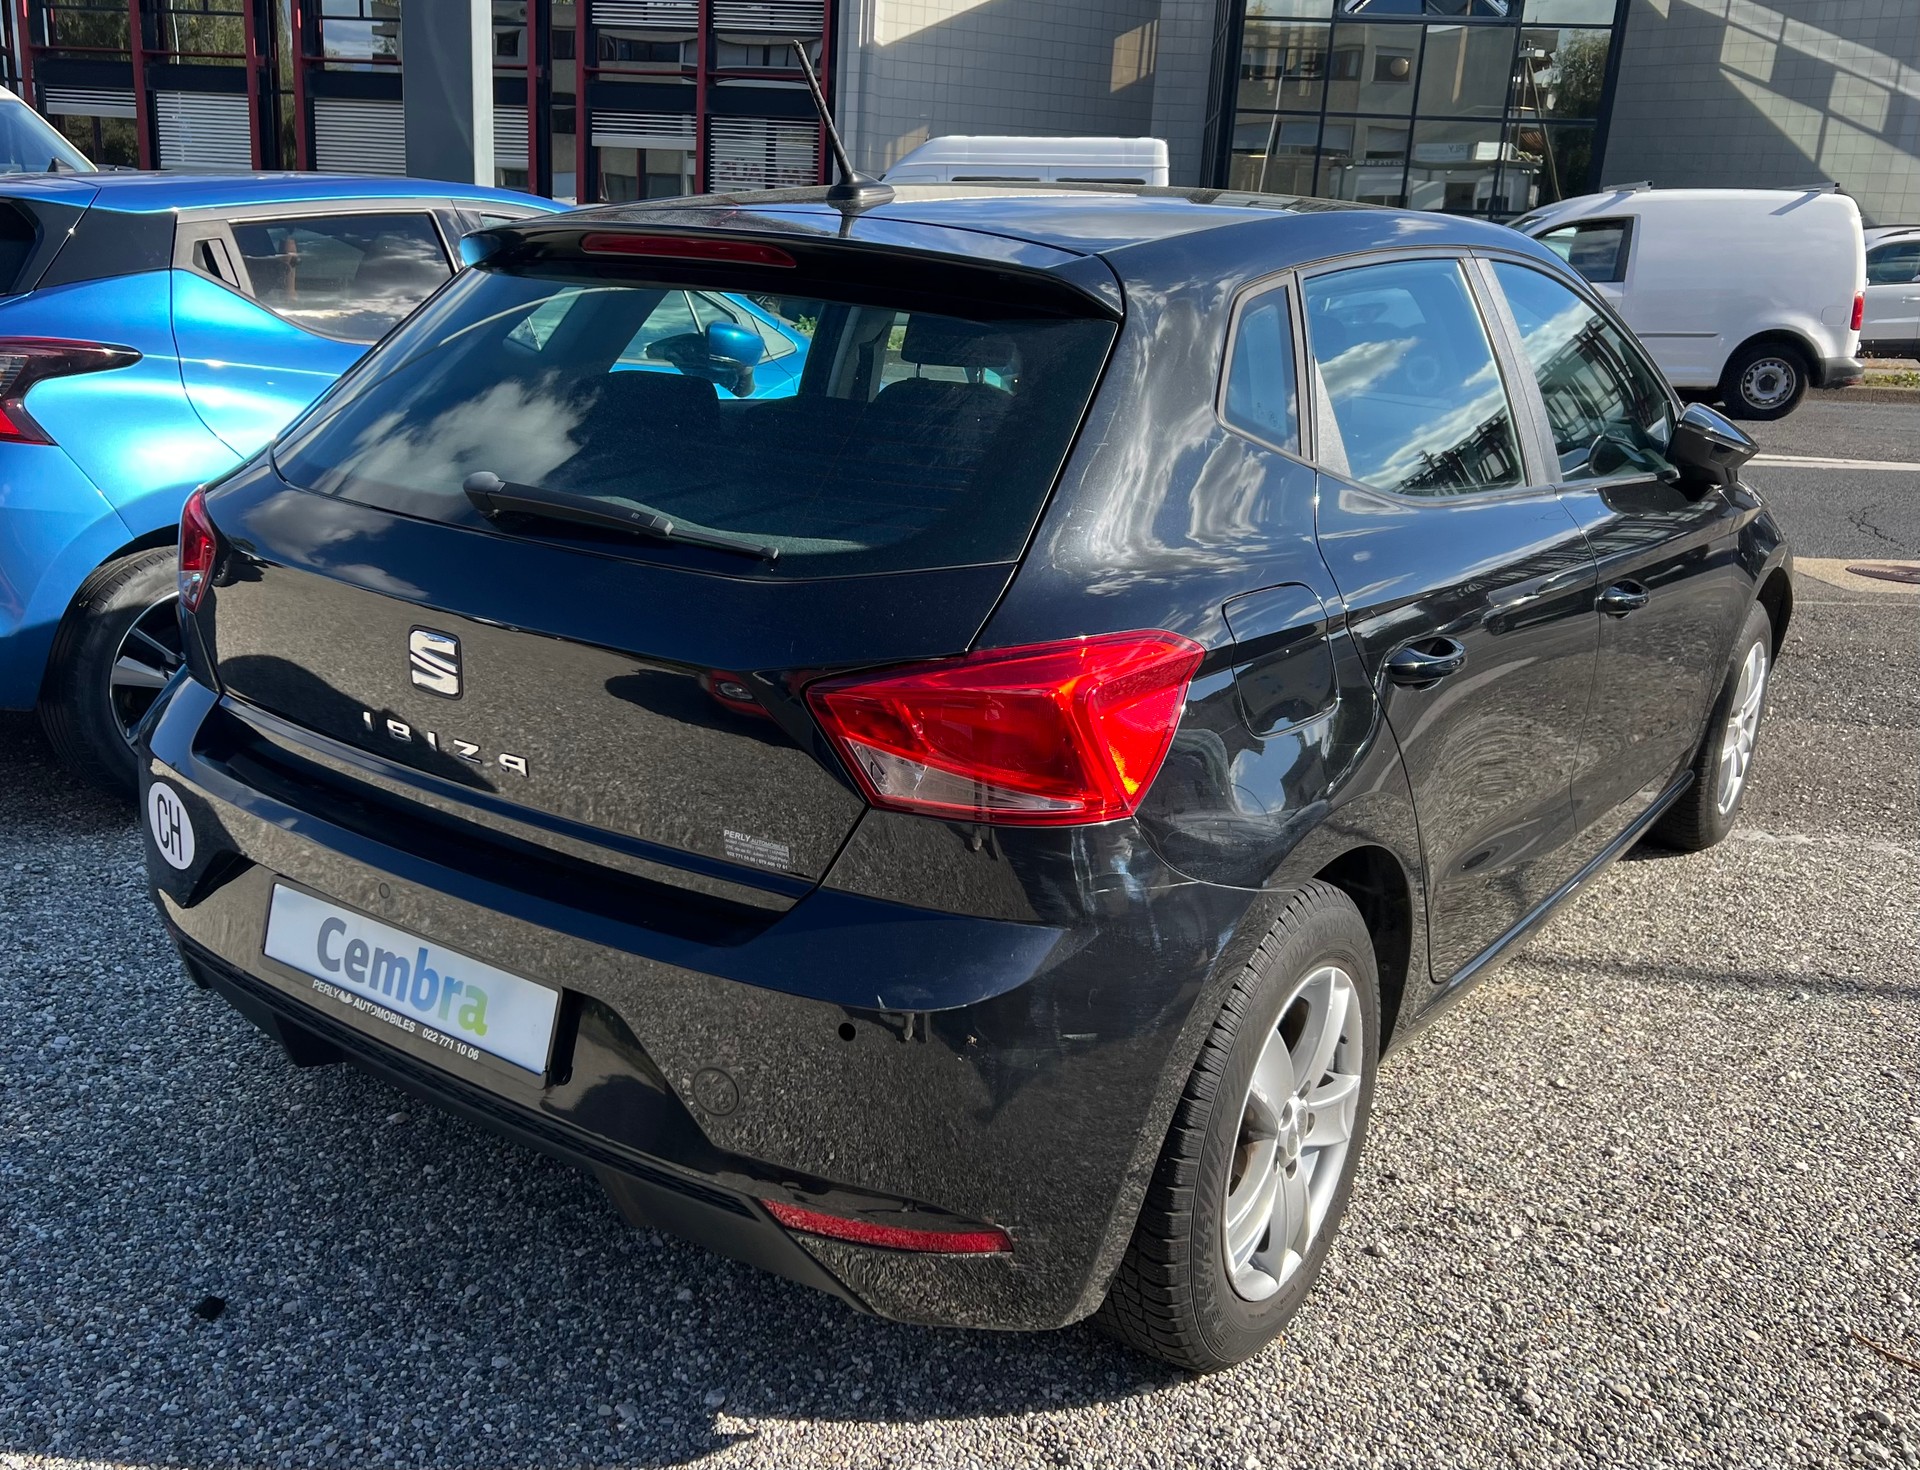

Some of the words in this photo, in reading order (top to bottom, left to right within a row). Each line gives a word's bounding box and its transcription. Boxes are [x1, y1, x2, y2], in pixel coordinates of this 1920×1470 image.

[363, 711, 529, 777] IBIZA
[157, 794, 183, 862] CH
[724, 829, 751, 842] PERLY
[312, 979, 340, 1000] PERLY
[352, 998, 416, 1034] AUTOMOBILES
[317, 916, 489, 1037] Cembra
[422, 1028, 438, 1046] 022
[440, 1034, 454, 1051] 771
[456, 1040, 467, 1056] 10
[468, 1044, 480, 1060] 06
